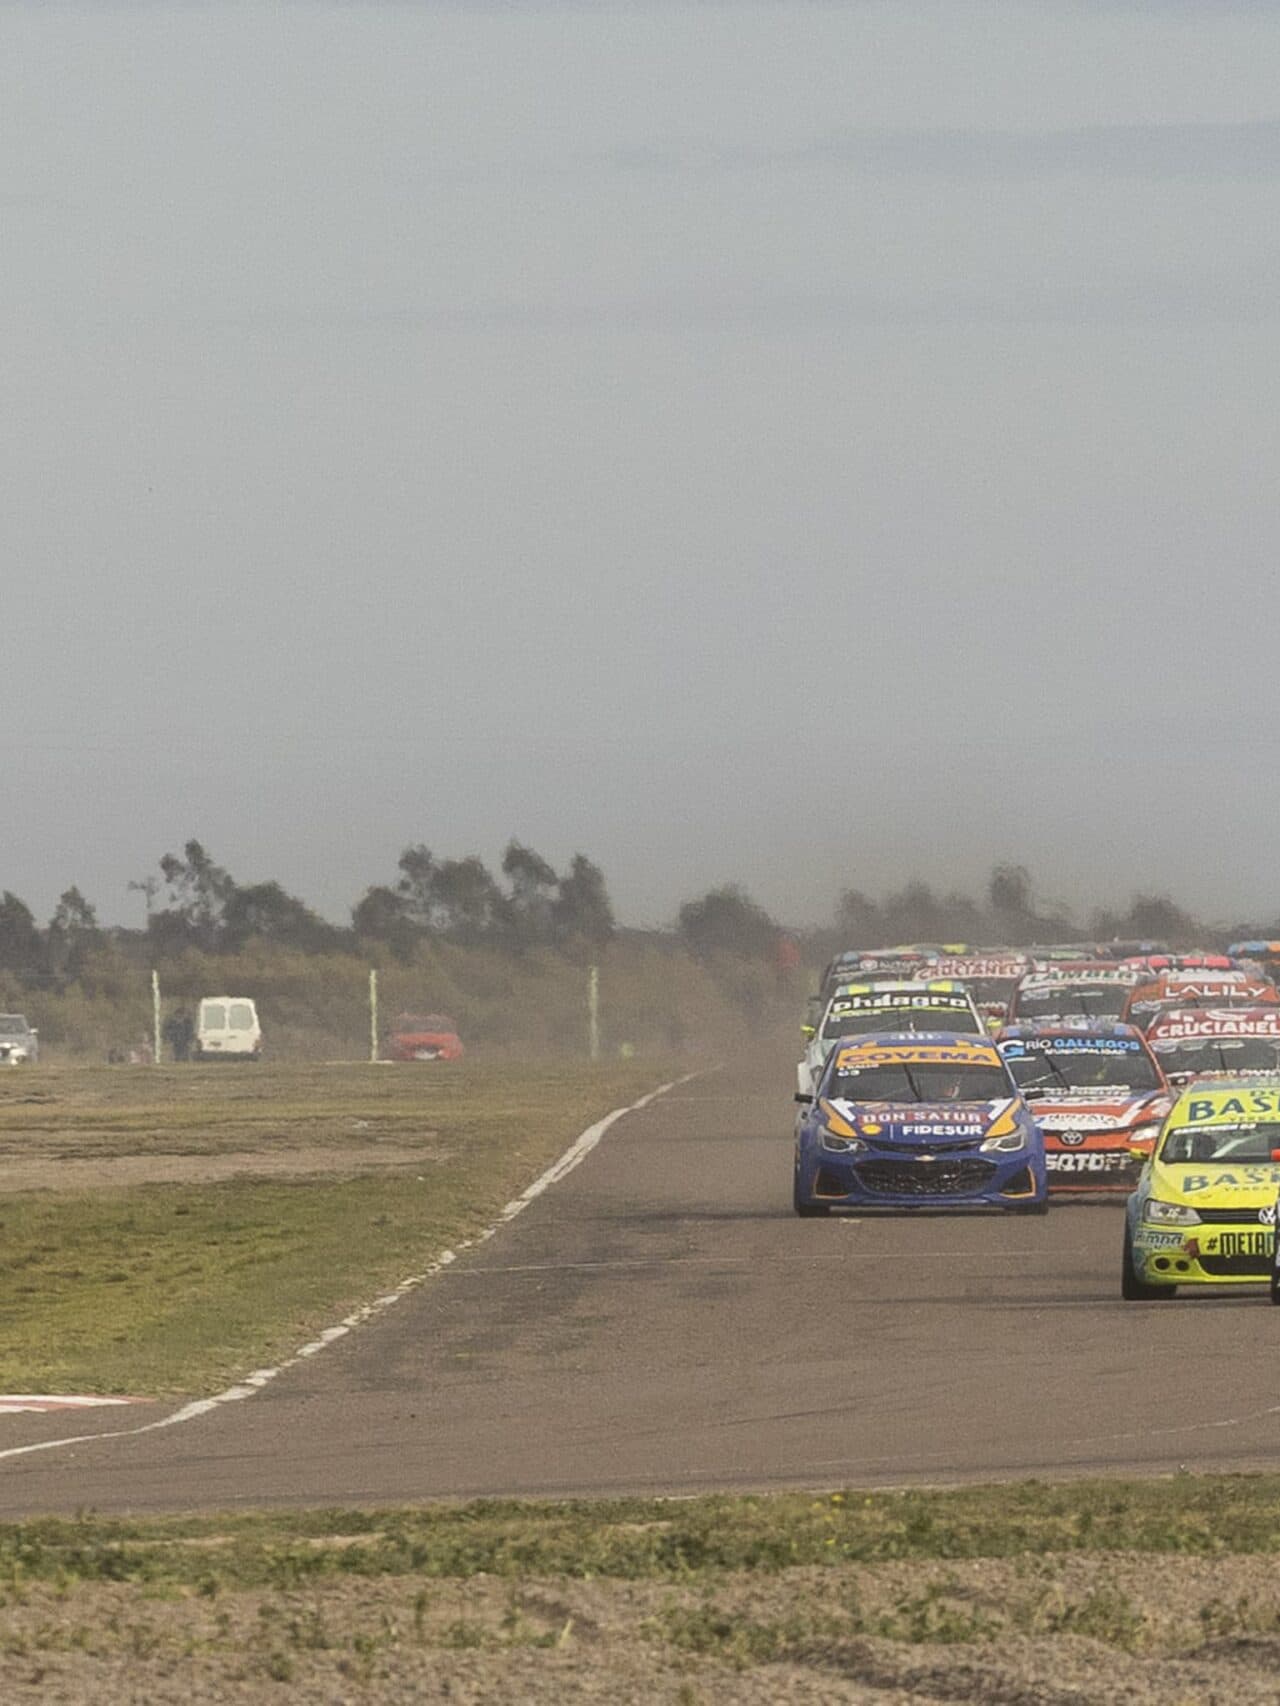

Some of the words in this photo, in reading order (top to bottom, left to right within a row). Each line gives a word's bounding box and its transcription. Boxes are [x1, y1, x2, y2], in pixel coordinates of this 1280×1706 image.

[1165, 983, 1266, 997] LALILY
[1053, 1038, 1140, 1050] GALLEGOS
[843, 1051, 992, 1062] COVEMA
[863, 1112, 906, 1124] DON
[914, 1111, 981, 1122] SATUR
[902, 1124, 983, 1136] FIDESUR
